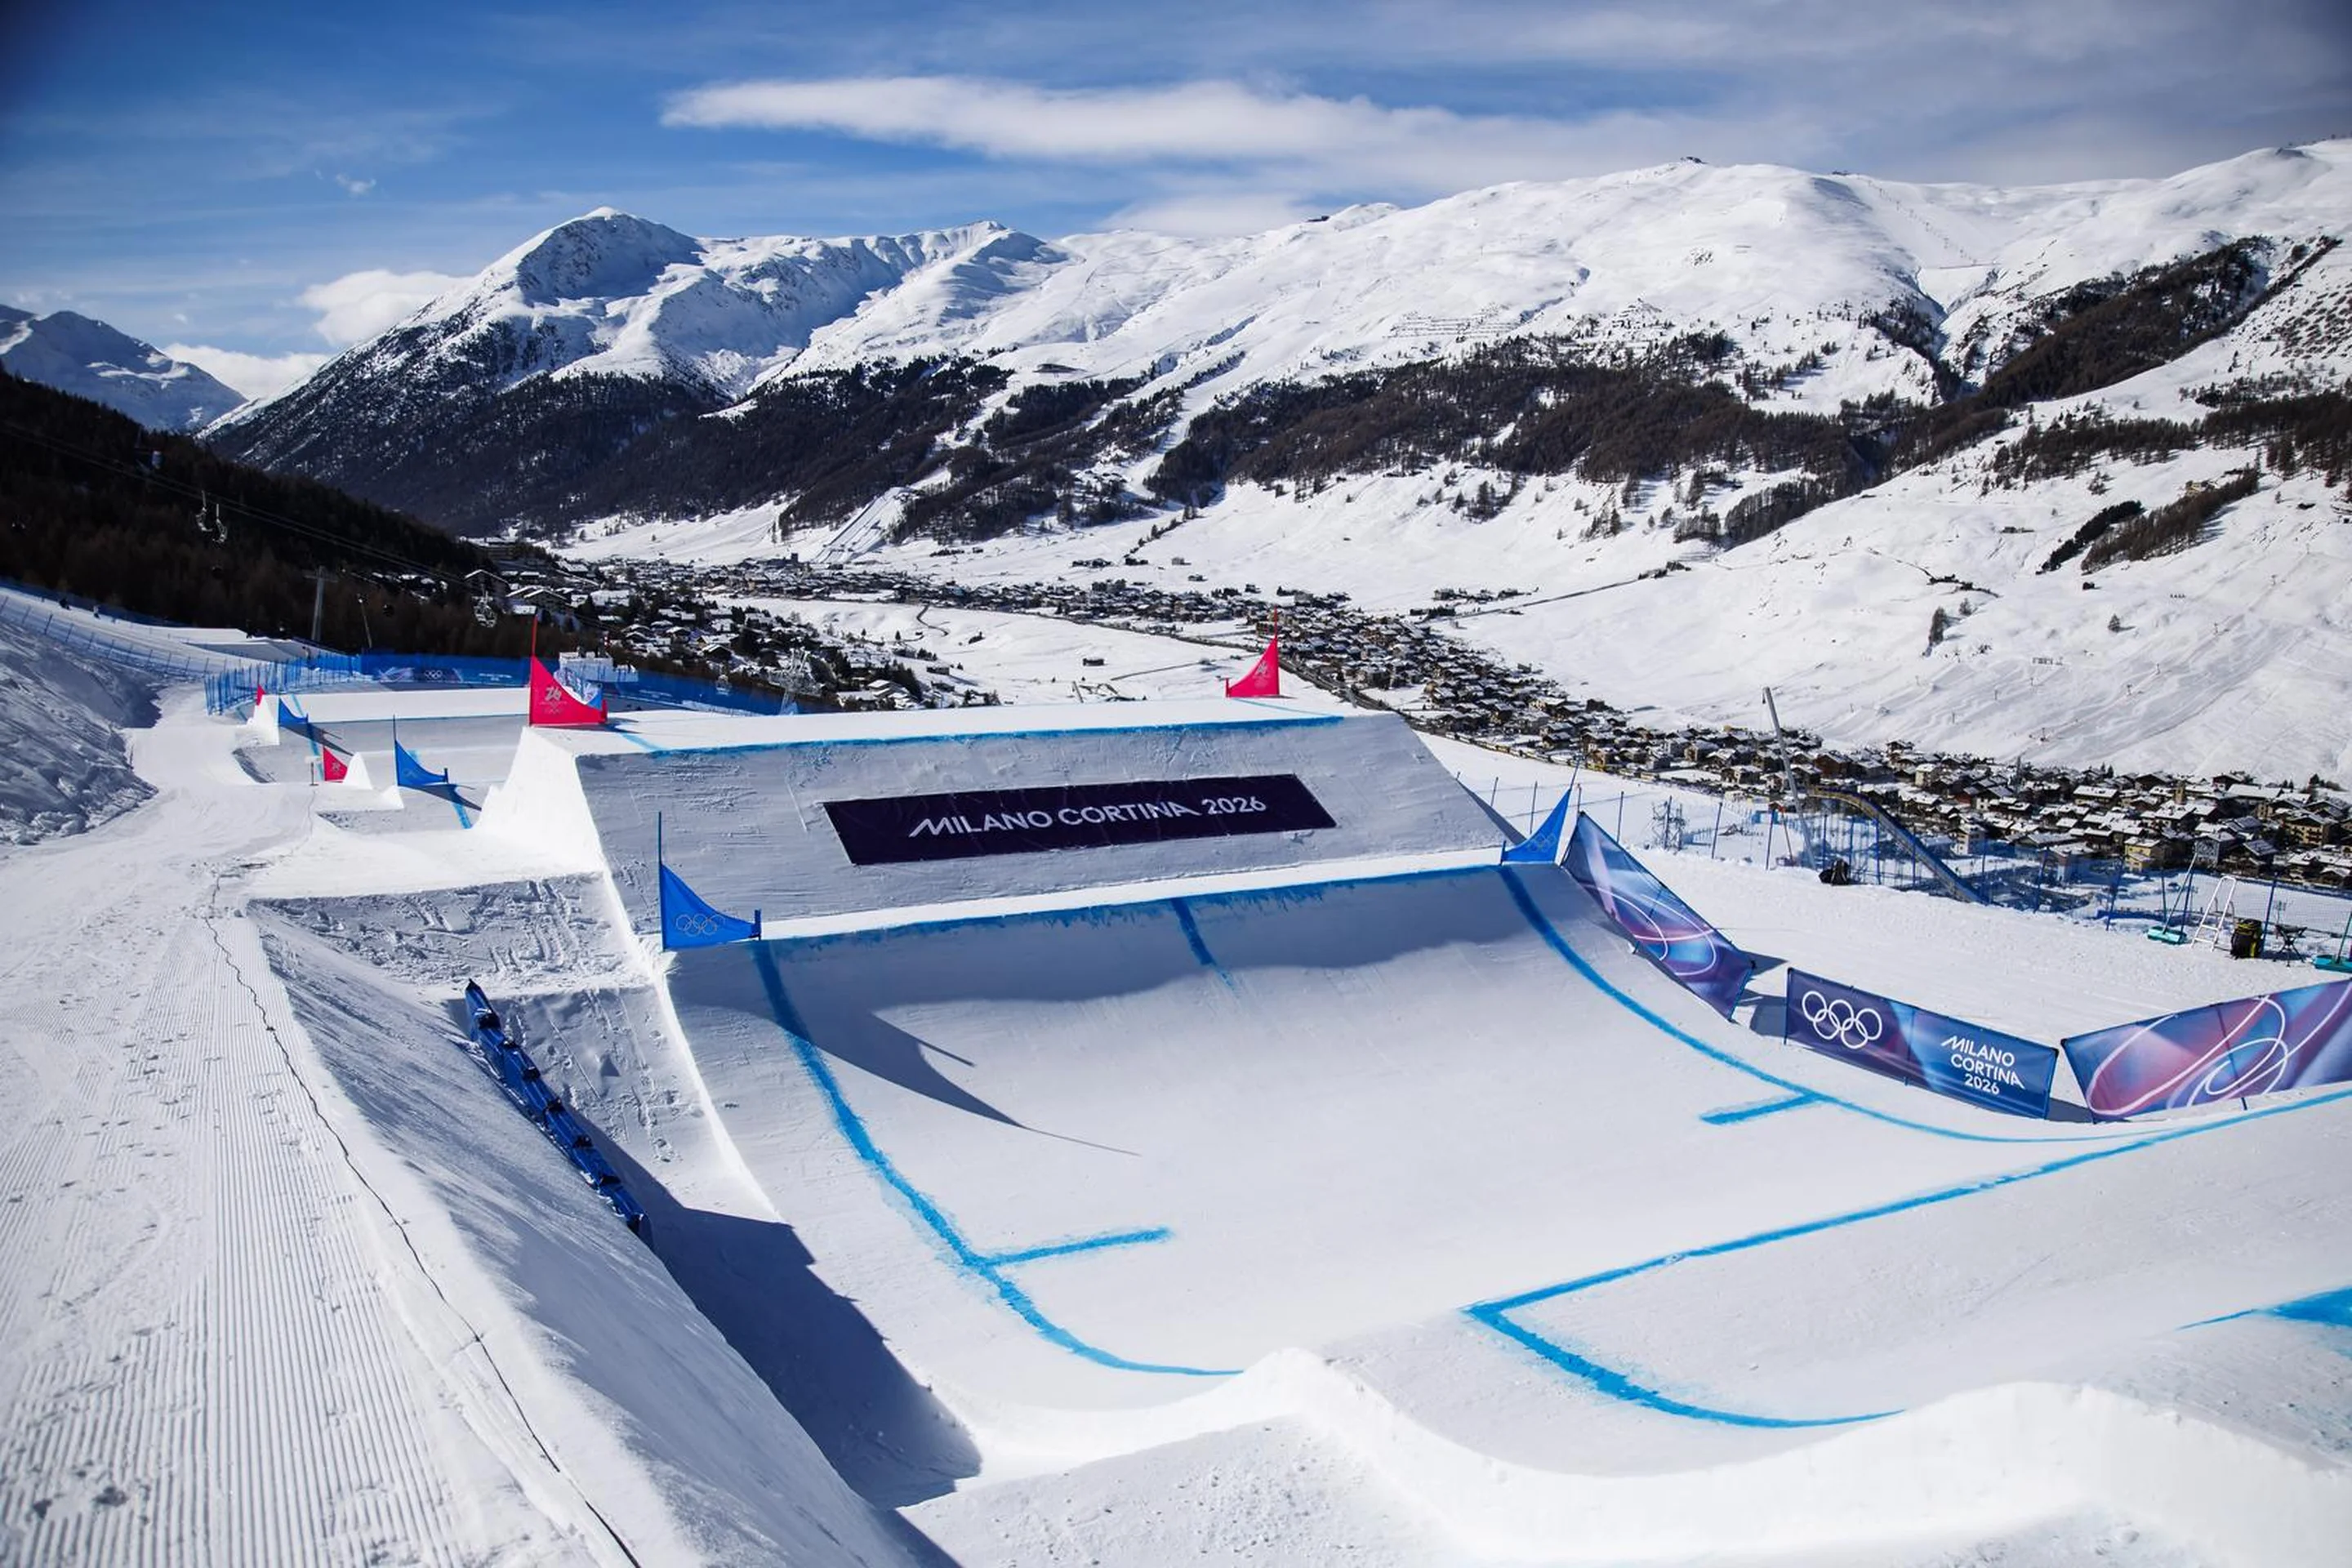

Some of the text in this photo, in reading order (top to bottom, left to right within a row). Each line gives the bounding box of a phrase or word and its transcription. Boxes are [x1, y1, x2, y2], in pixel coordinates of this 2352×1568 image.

[908, 796, 1267, 838] MILANO CORTINA 2026
[1940, 1036, 2015, 1067] MILANO
[1950, 1054, 2025, 1089] CORTINA
[1964, 1073, 2000, 1095] 2026
